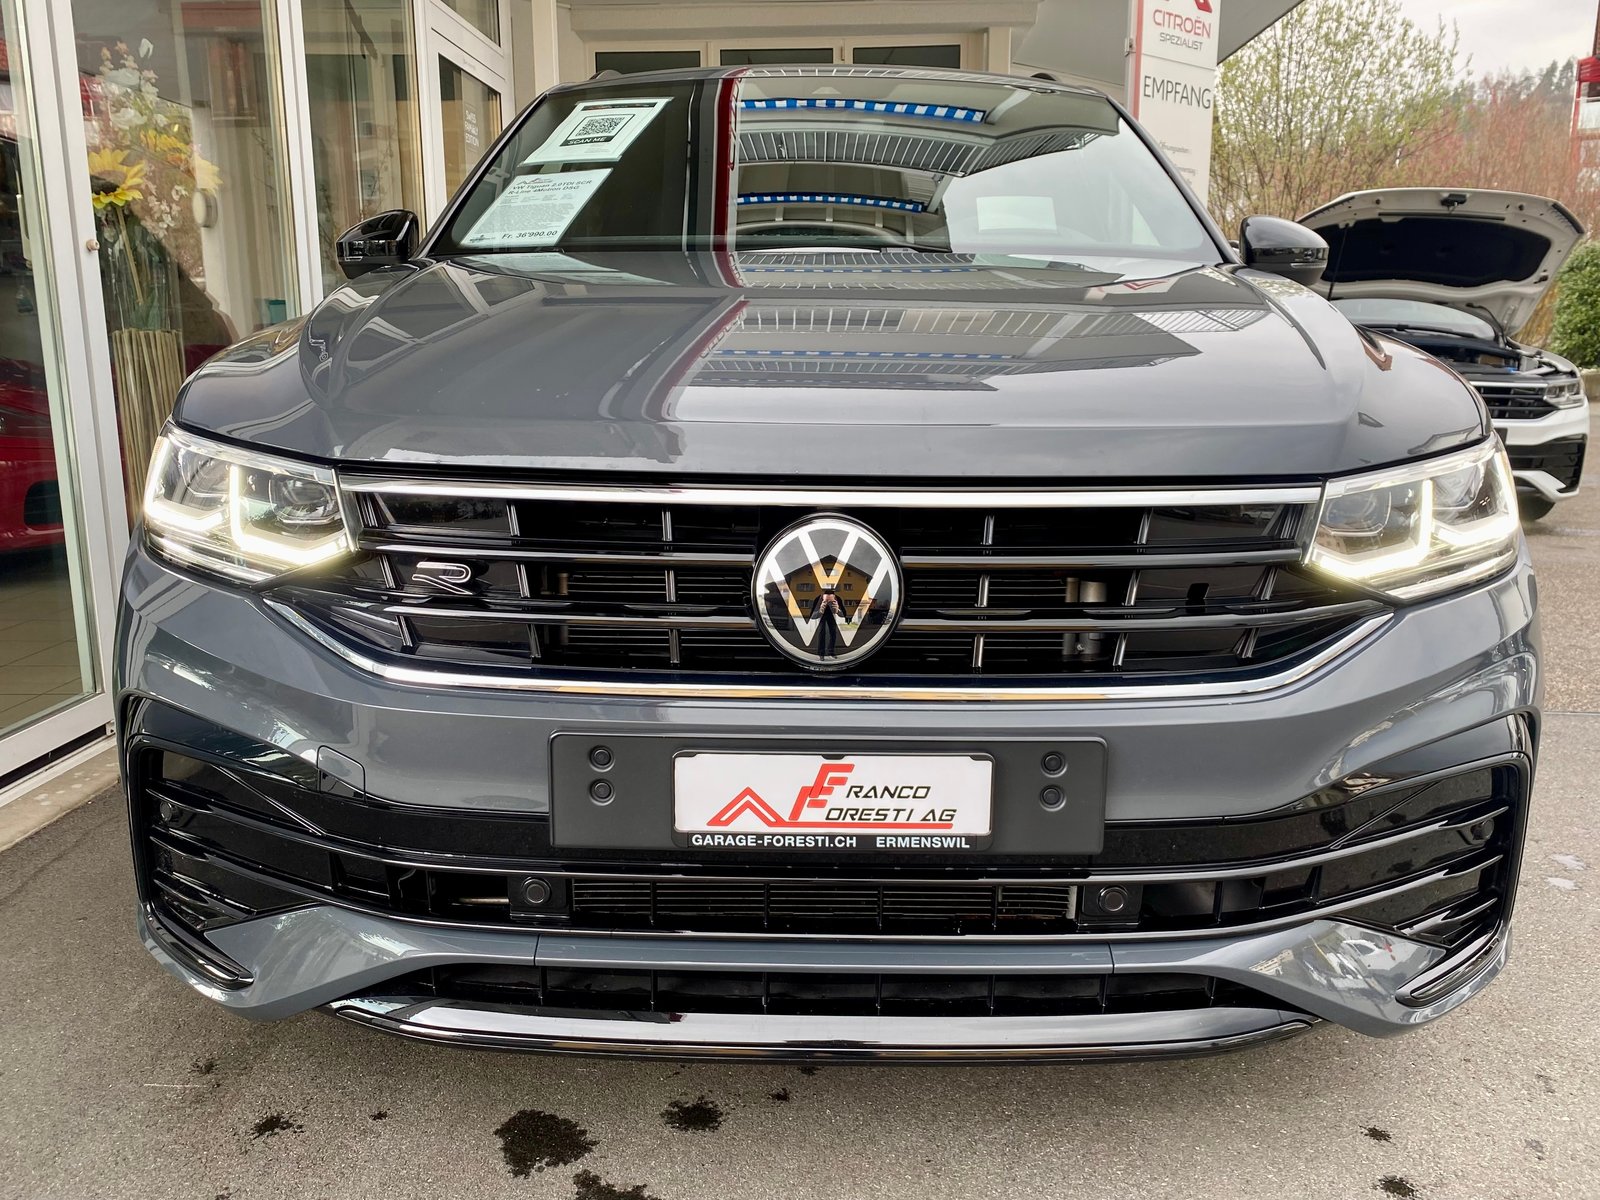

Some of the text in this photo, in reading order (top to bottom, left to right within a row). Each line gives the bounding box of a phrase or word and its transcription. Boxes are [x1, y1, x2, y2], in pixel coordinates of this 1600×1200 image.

[1153, 9, 1211, 39] CITROËN
[1159, 32, 1203, 52] SPEZIALIST
[1143, 75, 1211, 110] EMPFANG
[515, 230, 558, 239] 36'990.00
[411, 561, 473, 595] R
[919, 808, 957, 822] AG
[691, 834, 970, 848] GARAGE-FORESTI.CH ERMENSWIL
